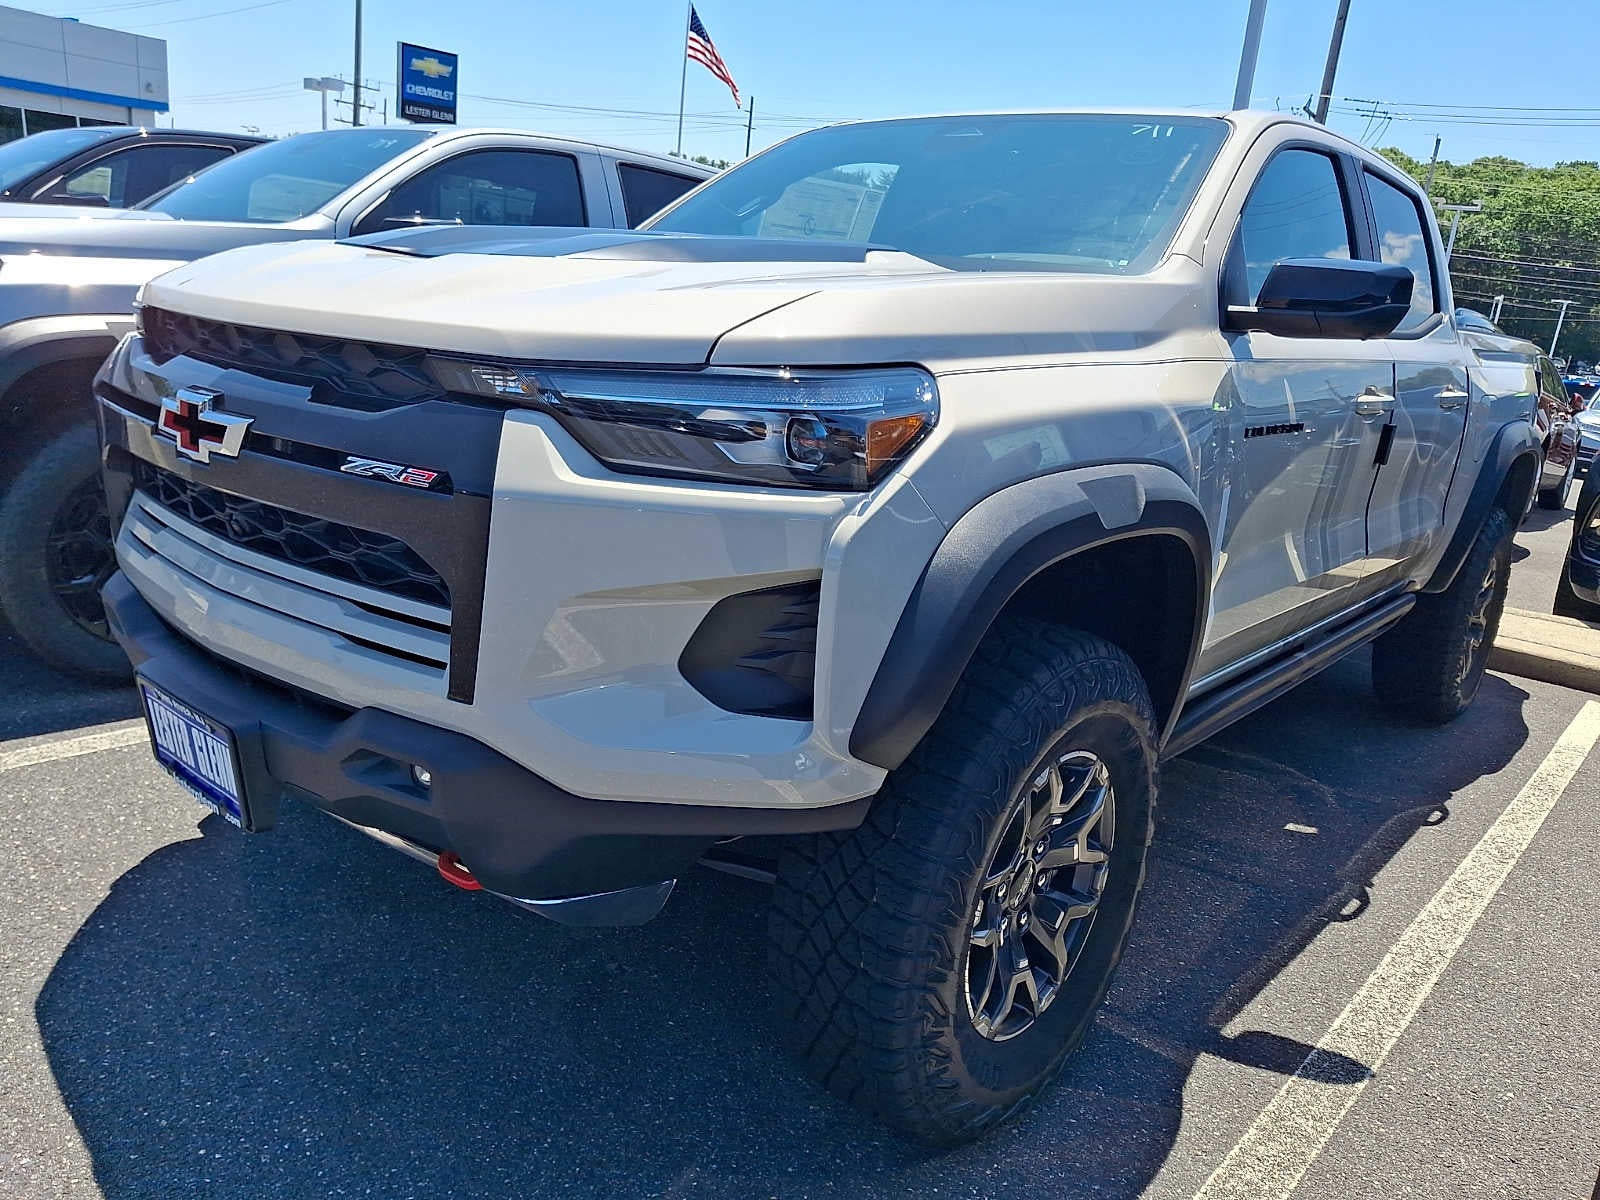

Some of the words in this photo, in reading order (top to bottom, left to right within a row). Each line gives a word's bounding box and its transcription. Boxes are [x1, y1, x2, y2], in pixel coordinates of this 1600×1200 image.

[406, 83, 454, 101] CHEVROLET
[405, 105, 431, 118] LESTER
[432, 109, 454, 122] GLENN
[340, 456, 438, 488] ZR2
[147, 697, 196, 769] LESTER
[191, 725, 238, 798] GLENN
